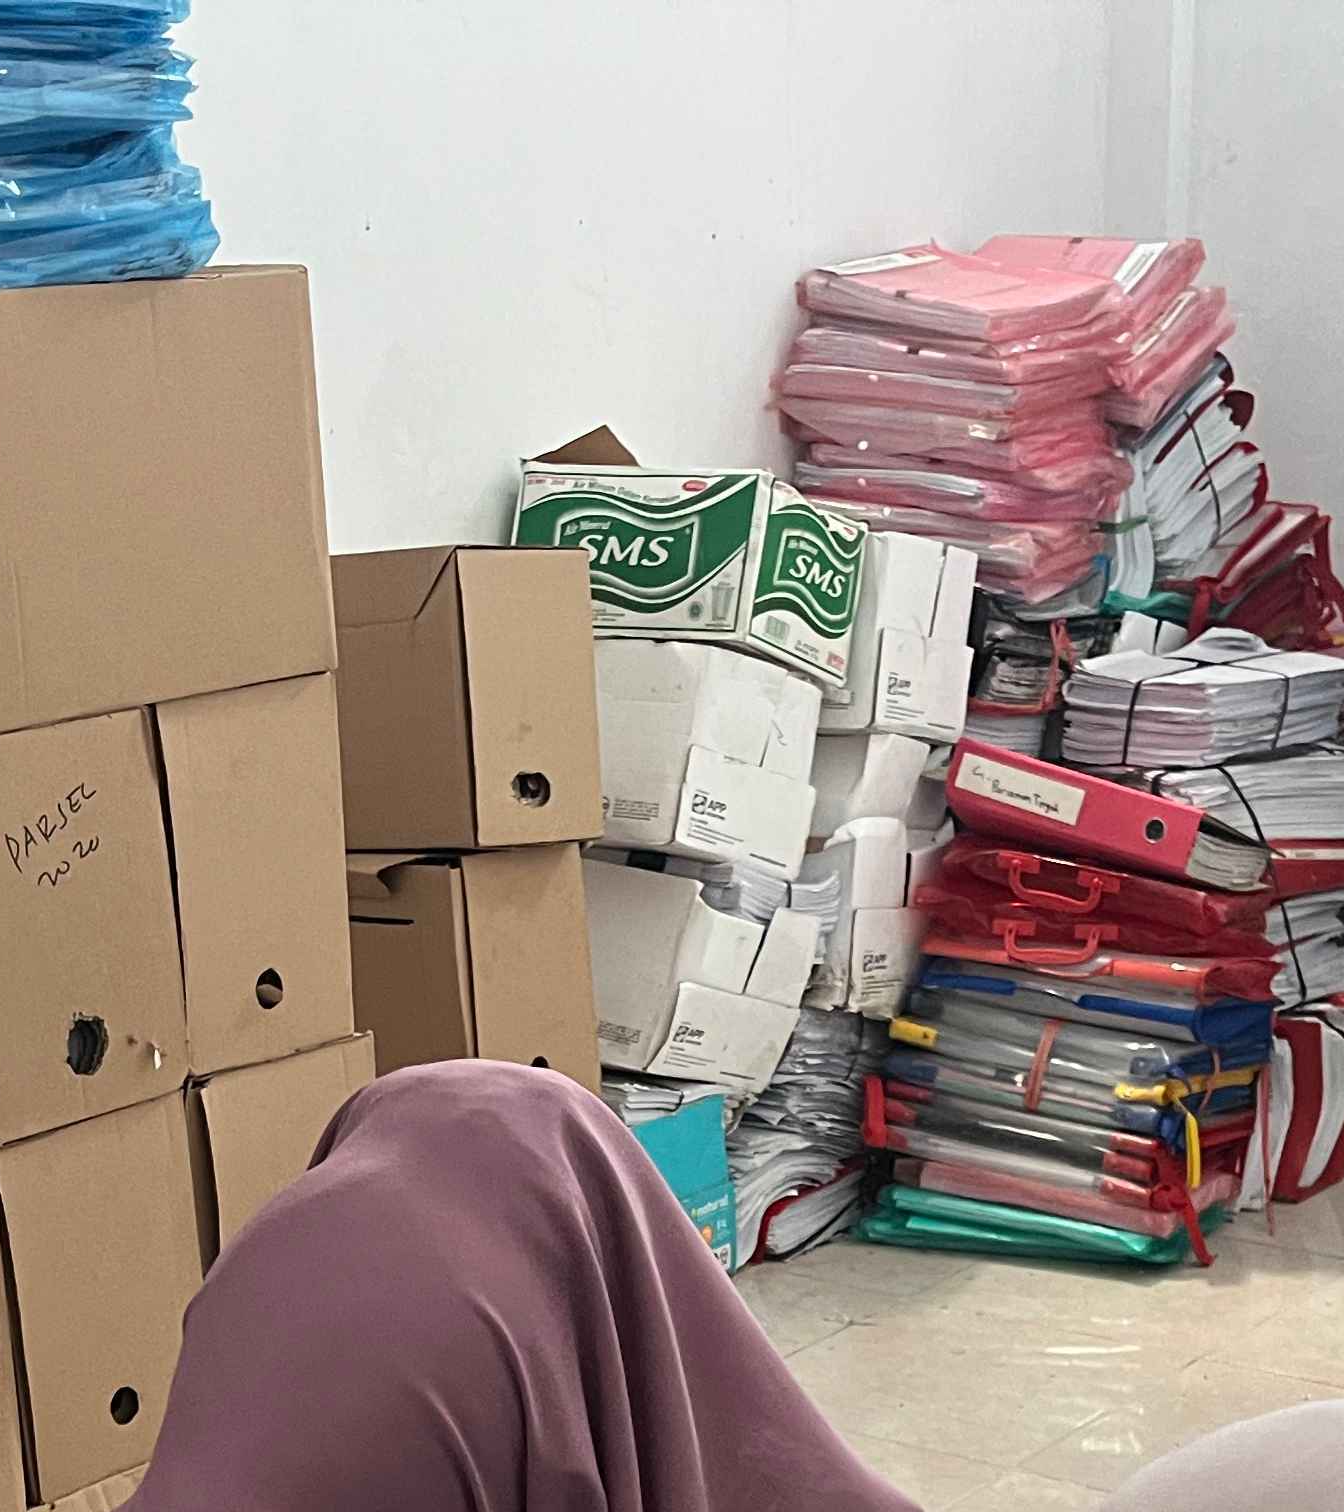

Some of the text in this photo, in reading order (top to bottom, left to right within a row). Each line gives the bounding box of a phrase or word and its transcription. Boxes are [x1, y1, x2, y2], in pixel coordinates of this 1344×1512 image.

[579, 534, 675, 567] SMS
[788, 554, 846, 598] SMS
[4, 782, 97, 874] PARSEL
